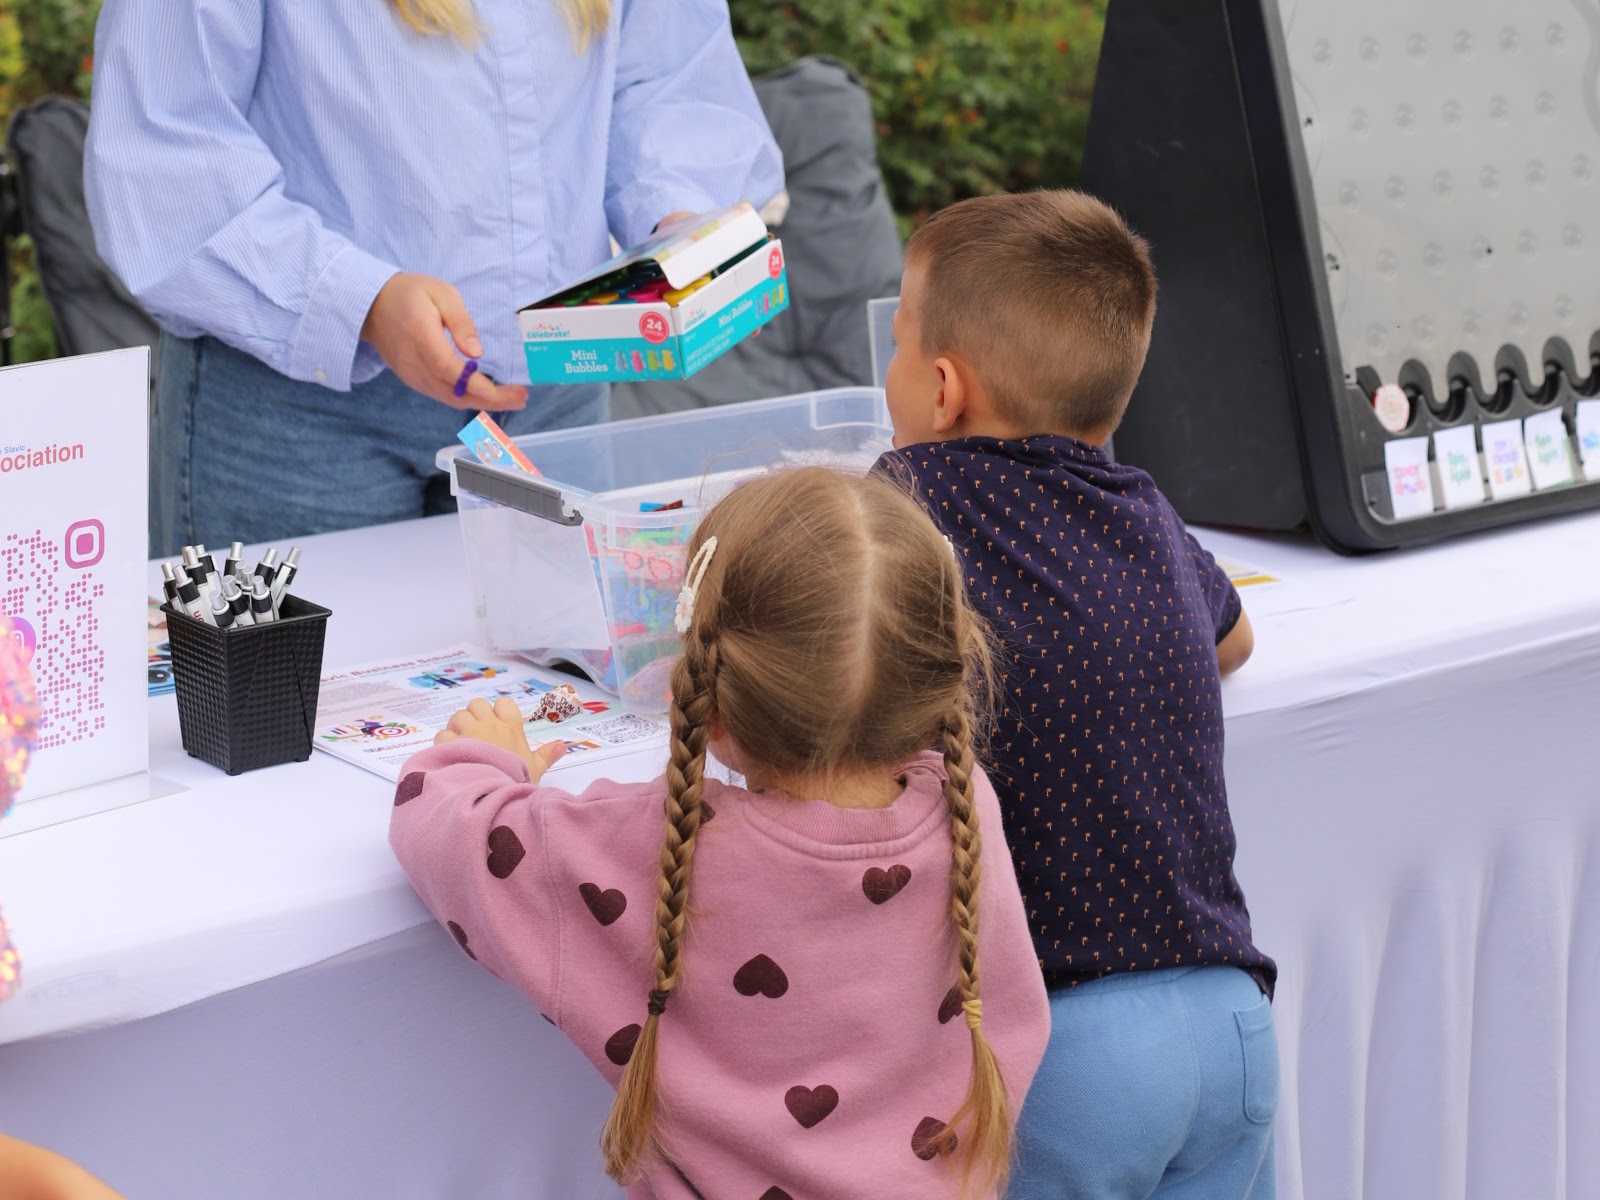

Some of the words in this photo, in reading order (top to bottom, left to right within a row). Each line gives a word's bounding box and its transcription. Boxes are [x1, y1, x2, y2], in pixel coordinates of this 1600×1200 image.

[646, 318, 663, 332] 24
[571, 350, 597, 361] Mini
[565, 361, 609, 374] Bubbles
[4, 444, 26, 454] Slavic
[0, 443, 84, 473] ociation
[350, 660, 415, 676] Business
[417, 650, 465, 664] School
